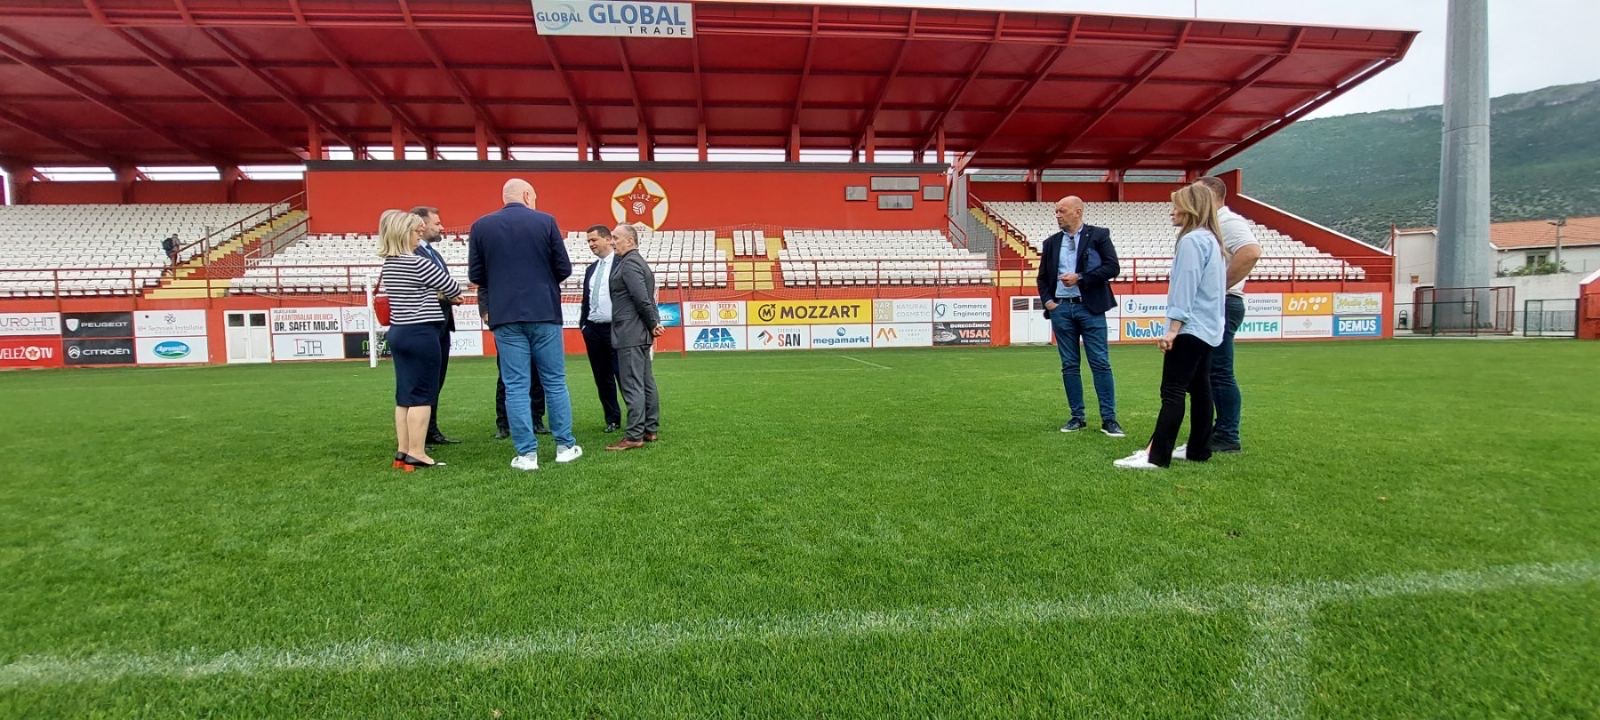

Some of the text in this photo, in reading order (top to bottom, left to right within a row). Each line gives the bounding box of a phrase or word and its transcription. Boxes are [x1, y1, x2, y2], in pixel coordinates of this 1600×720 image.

[536, 11, 583, 23] GLOBAL
[588, 3, 687, 26] GLOBAL
[627, 26, 687, 35] TRADE
[780, 305, 860, 319] MOZZART
[953, 310, 991, 318] Engineering
[274, 318, 339, 331] DR. SAFET MUJIĆ
[1338, 319, 1376, 332] DEMUS
[695, 327, 735, 342] ASA
[777, 333, 801, 347] SAN
[813, 336, 869, 345] megamarkt
[40, 347, 54, 358] TV
[82, 347, 130, 356] CITROËN
